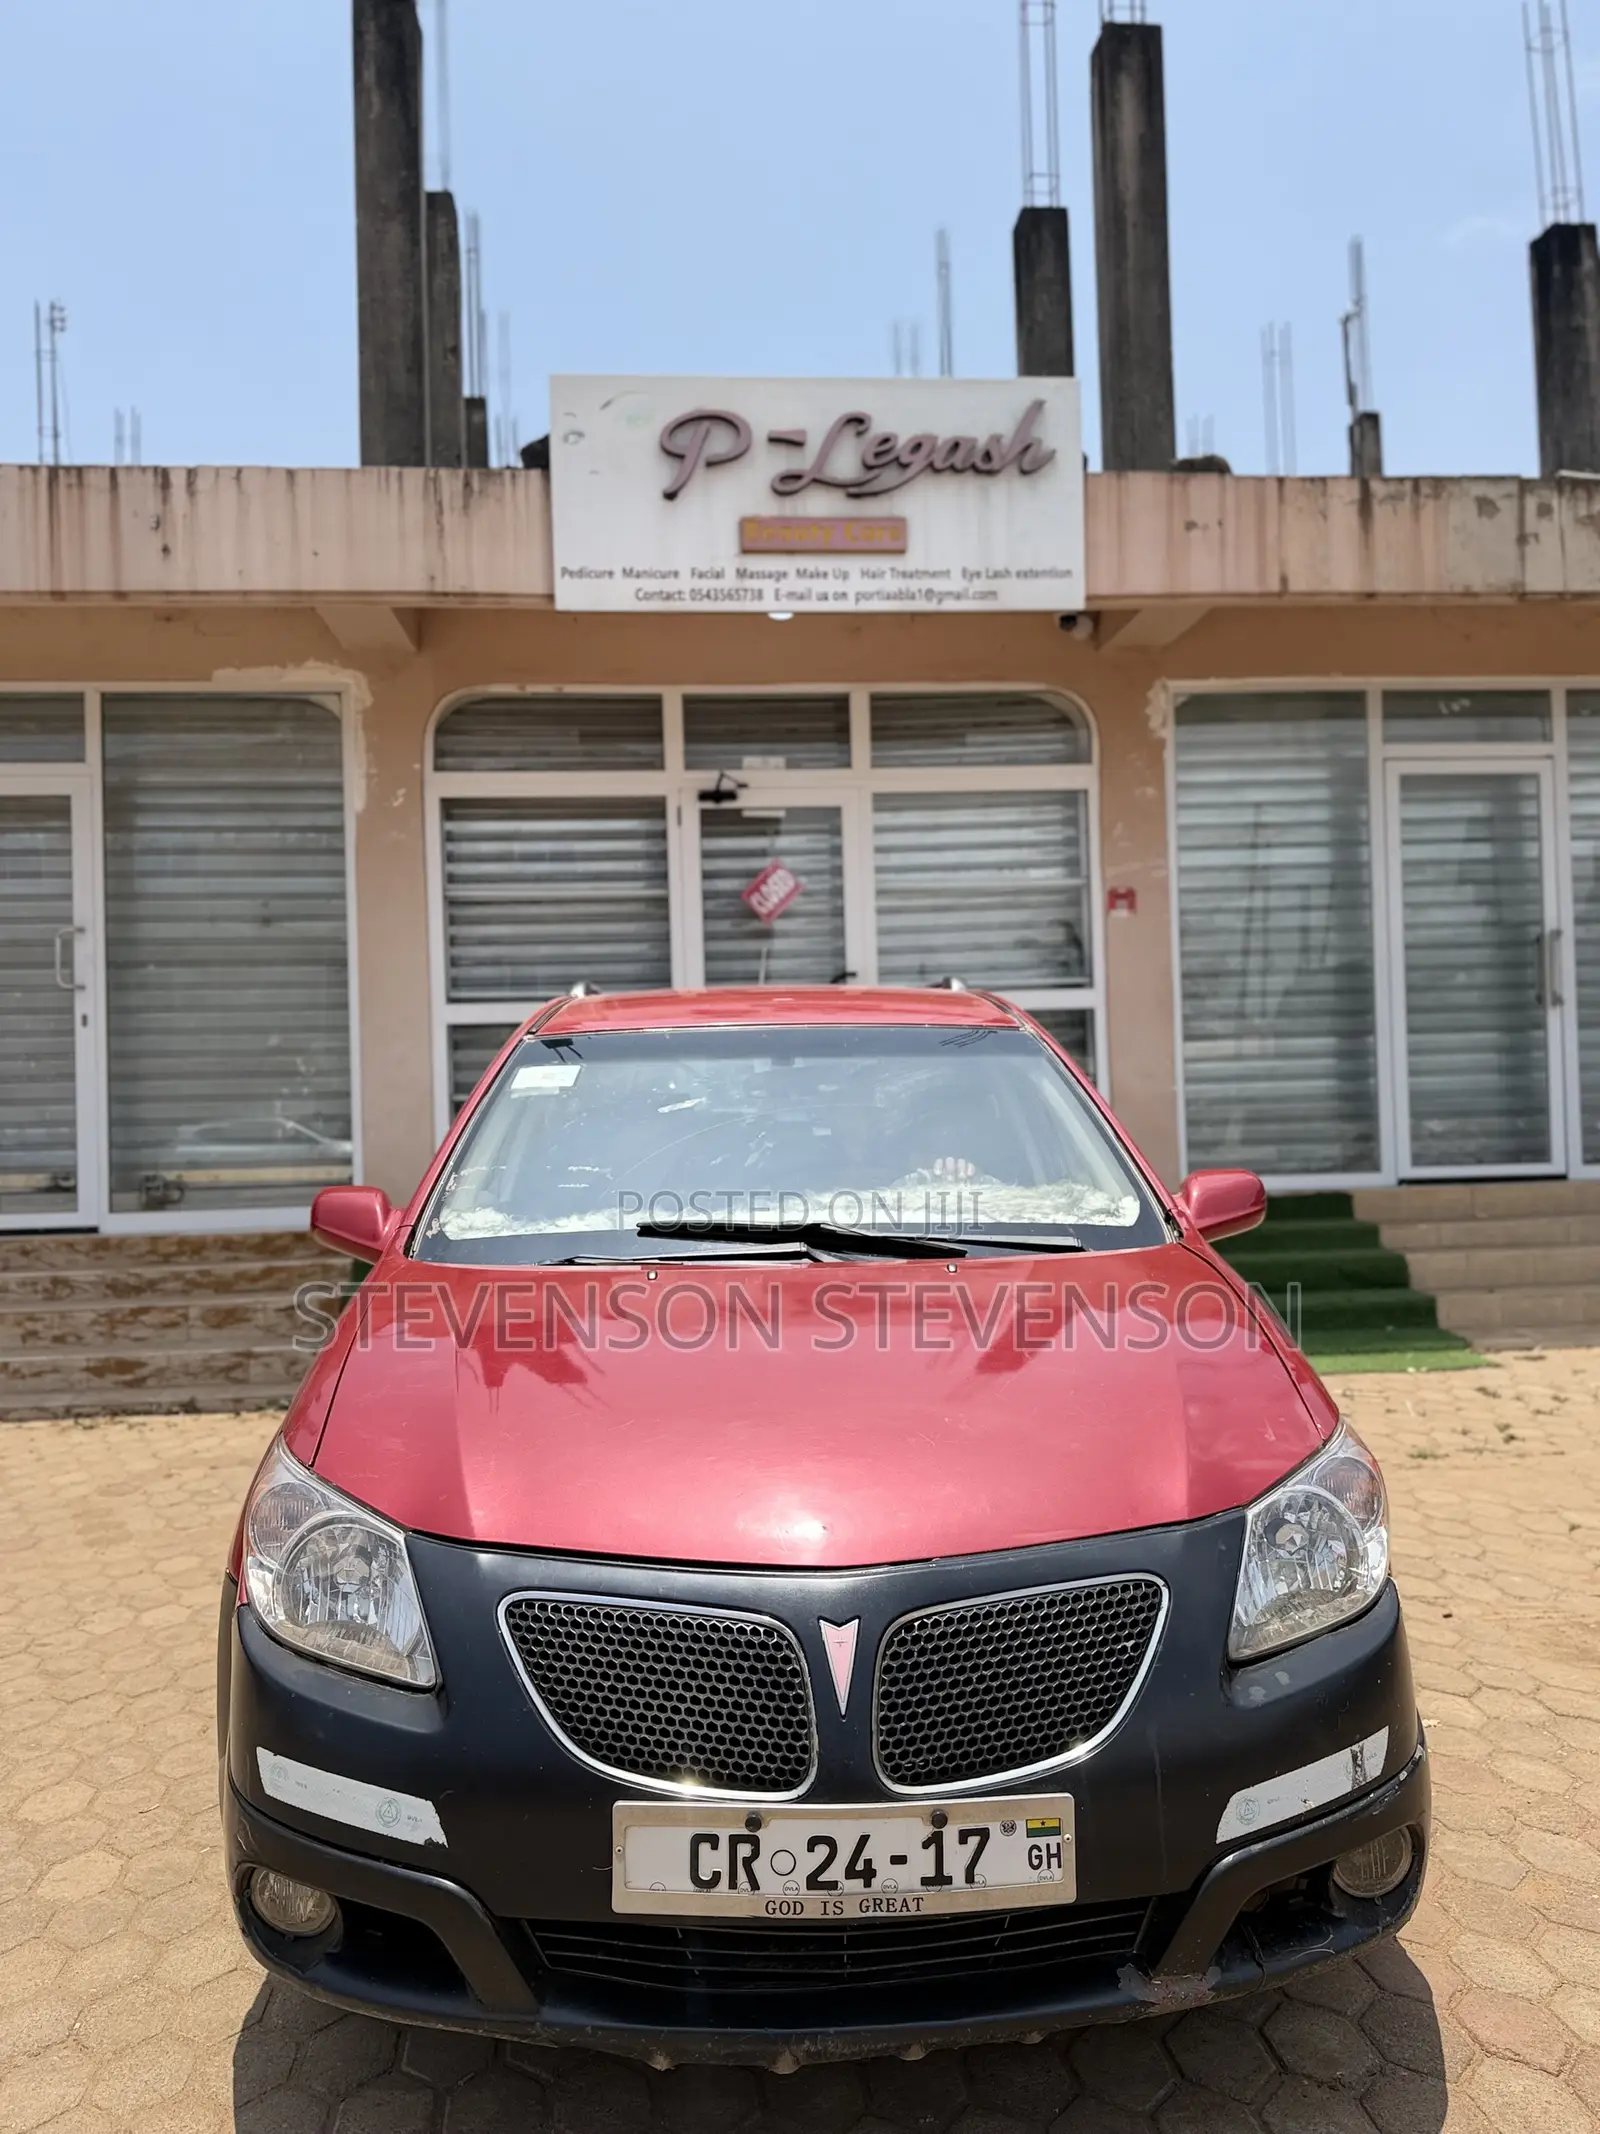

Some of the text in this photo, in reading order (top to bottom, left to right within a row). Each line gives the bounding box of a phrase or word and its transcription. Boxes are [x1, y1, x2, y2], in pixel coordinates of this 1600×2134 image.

[743, 520, 901, 547] Beauty Care
[560, 566, 615, 580] Pedicure
[622, 566, 680, 580] Manicure
[690, 566, 725, 580] Facial
[735, 566, 789, 583] Massage
[796, 566, 829, 580] Make
[832, 567, 850, 583] Up
[860, 567, 886, 580] Hair
[888, 567, 951, 580] Treatment
[961, 567, 982, 582] Eye
[985, 567, 1013, 580] Lash
[635, 587, 686, 602] Contact:
[774, 587, 812, 602] E-mail
[832, 590, 848, 602] on
[689, 1831, 760, 1891] CR
[1027, 1842, 1062, 1870] GH
[764, 1896, 924, 1916] GOD IS GREAT
